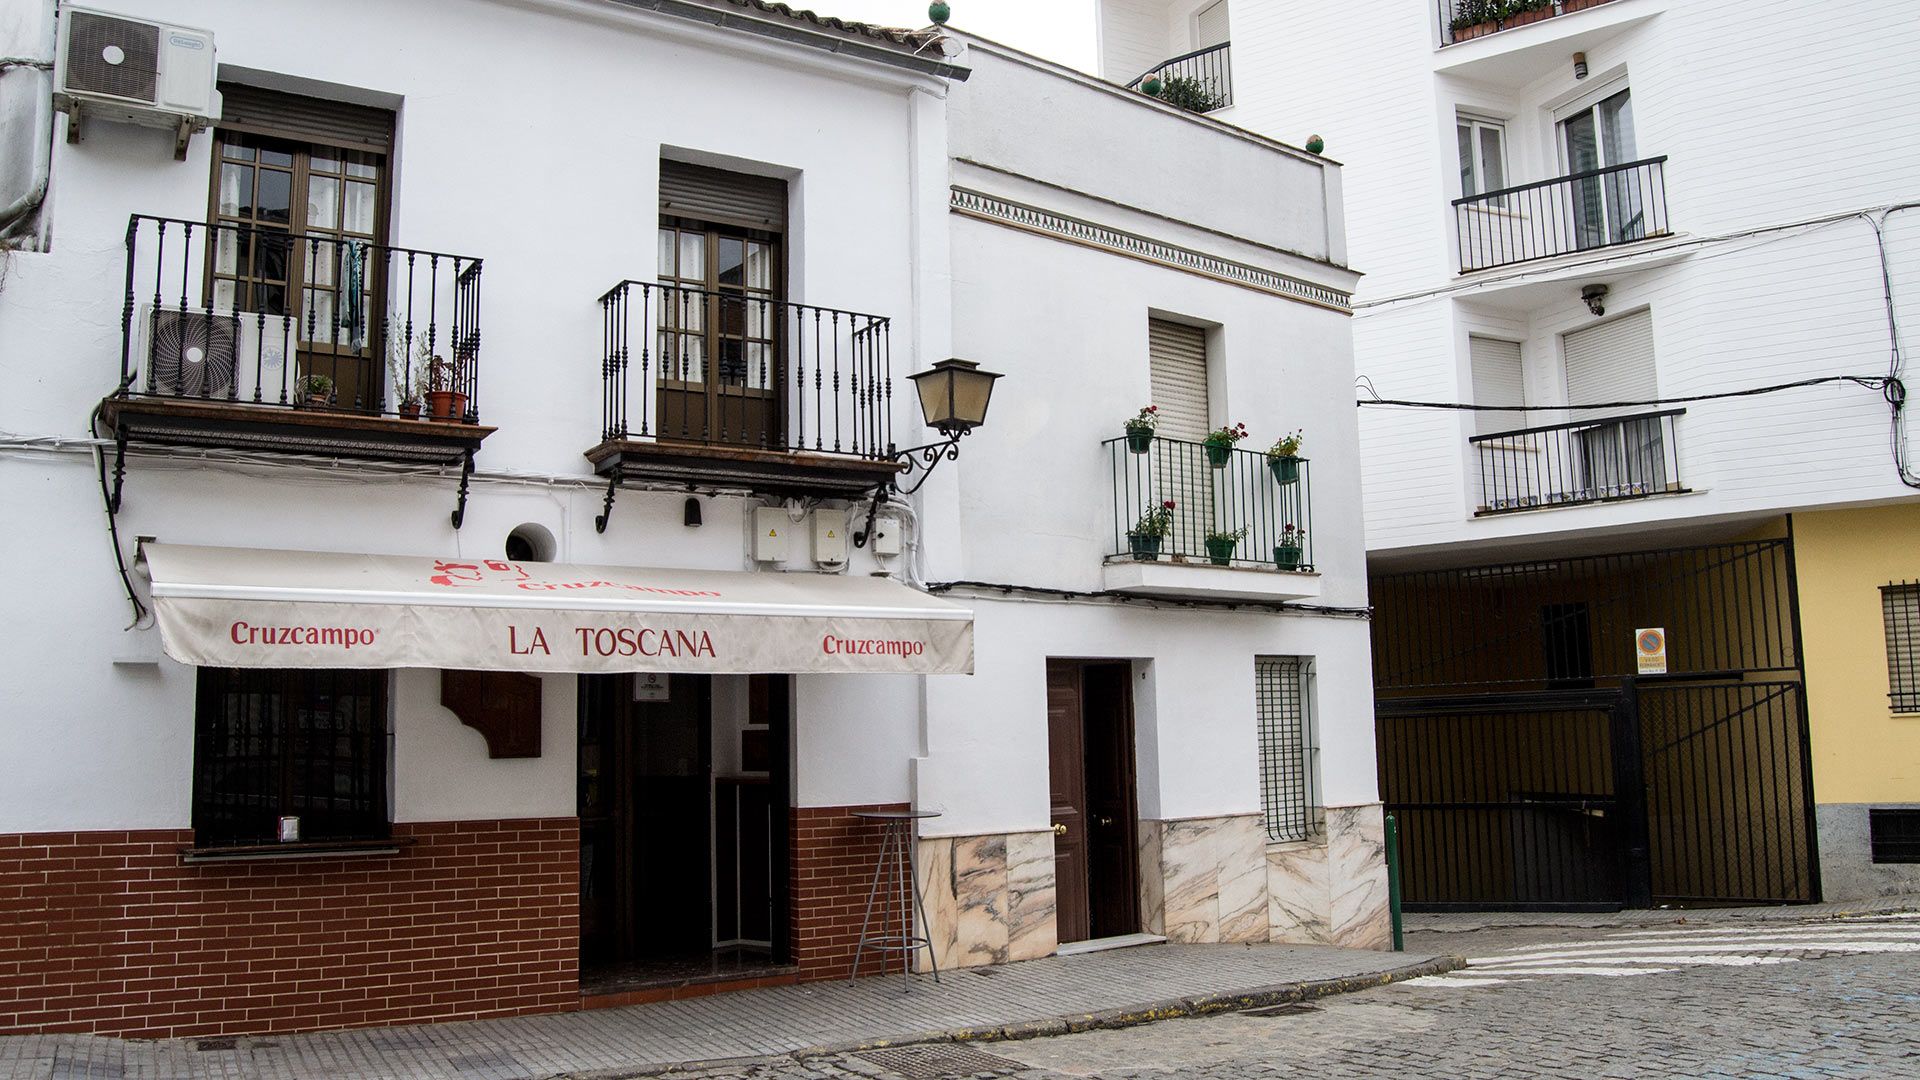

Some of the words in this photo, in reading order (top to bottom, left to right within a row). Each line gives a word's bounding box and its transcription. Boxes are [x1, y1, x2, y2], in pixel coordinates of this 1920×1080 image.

[230, 620, 375, 650] Cruzcampo
[508, 625, 551, 656] LA
[575, 627, 717, 658] TOSCANA
[822, 634, 924, 659] Cruzcampo
